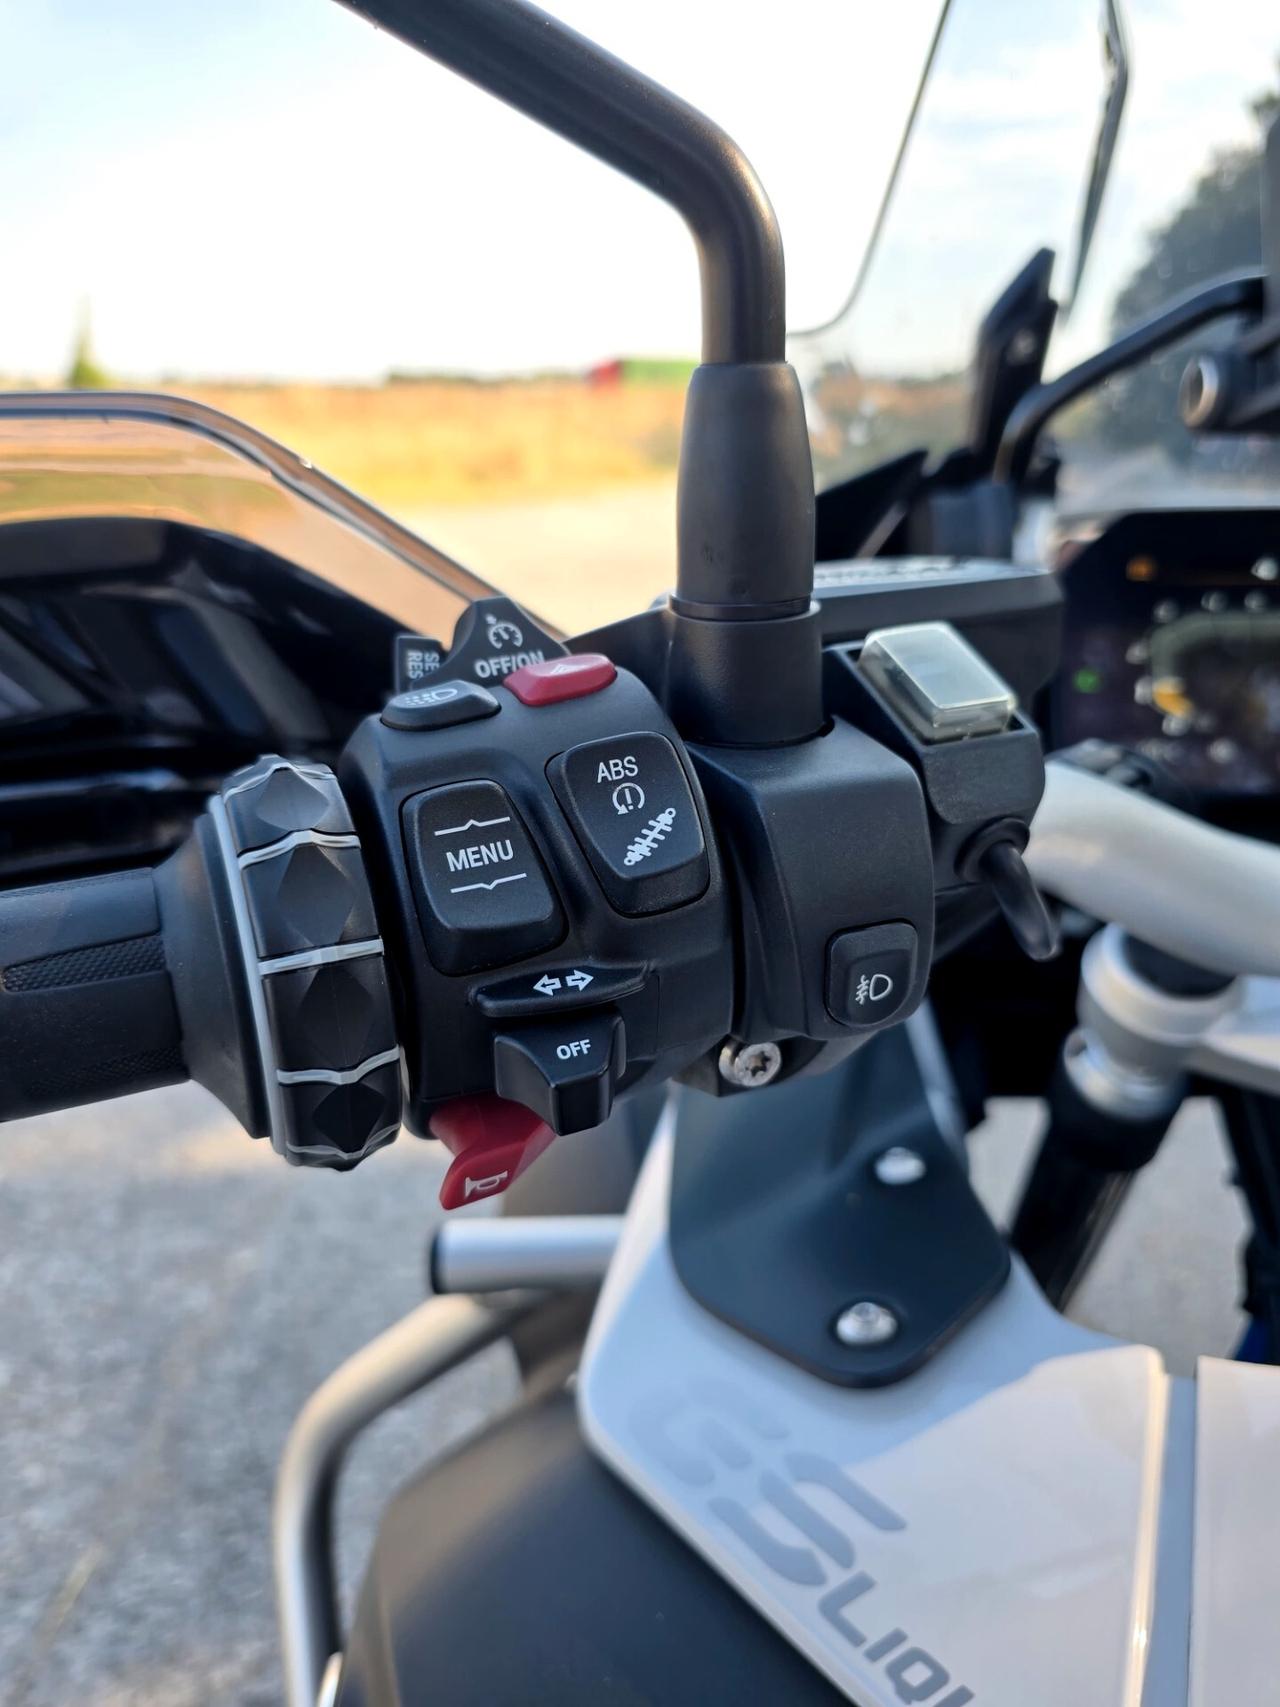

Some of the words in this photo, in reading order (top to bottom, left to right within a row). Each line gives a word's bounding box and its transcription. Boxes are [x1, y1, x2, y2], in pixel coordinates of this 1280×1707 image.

[408, 650, 424, 679] RES
[424, 652, 440, 671] SE
[475, 651, 546, 678] OFF/ON
[597, 756, 639, 783] ABS
[445, 839, 514, 872] MENU
[556, 1039, 591, 1060] OFF
